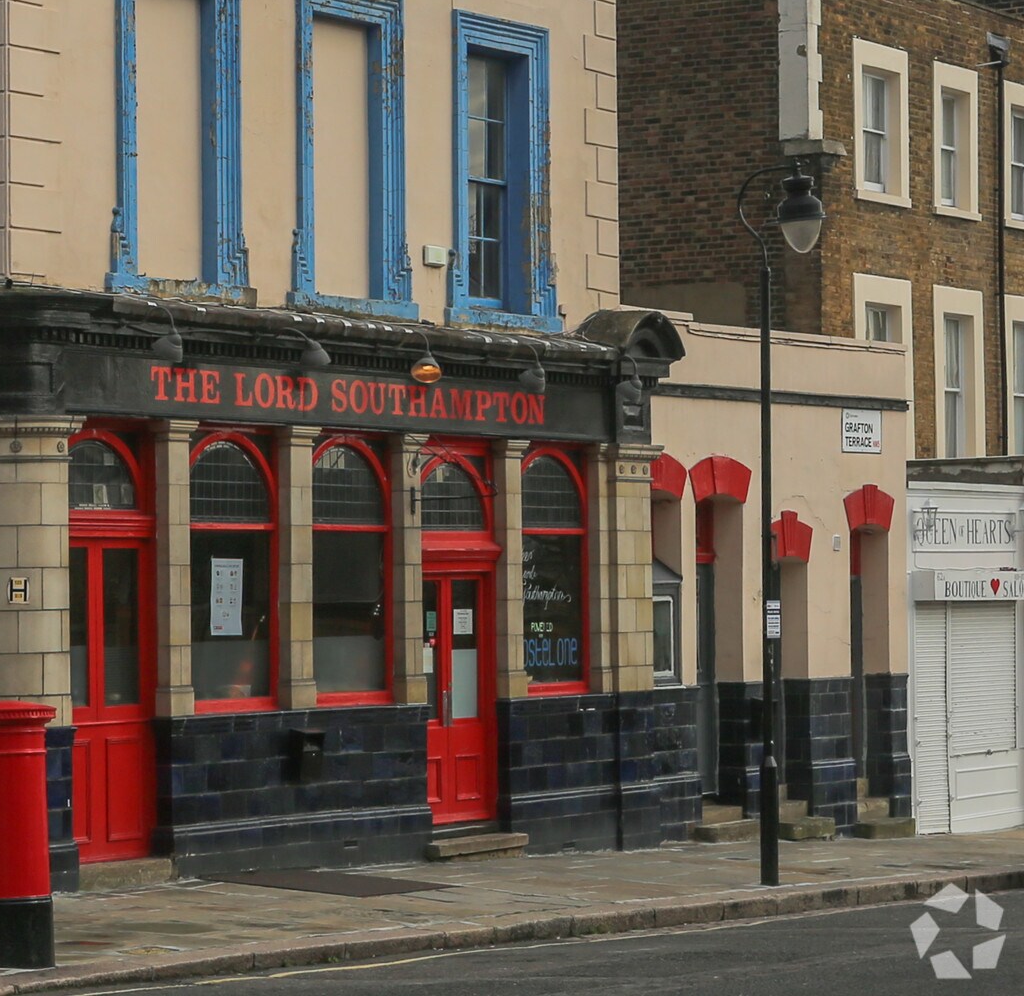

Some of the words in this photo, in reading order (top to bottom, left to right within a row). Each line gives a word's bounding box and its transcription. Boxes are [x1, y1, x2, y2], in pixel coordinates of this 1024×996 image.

[150, 365, 221, 405] THE
[233, 372, 319, 412] LORD
[331, 379, 547, 425] SOUTHAMPTON
[844, 421, 874, 434] GRAFTON
[844, 436, 872, 448] TERRACE
[916, 517, 957, 547] QUEEN
[966, 518, 1012, 545] HEARTS
[10, 579, 27, 602] H
[944, 580, 987, 599] BOUTIQUE
